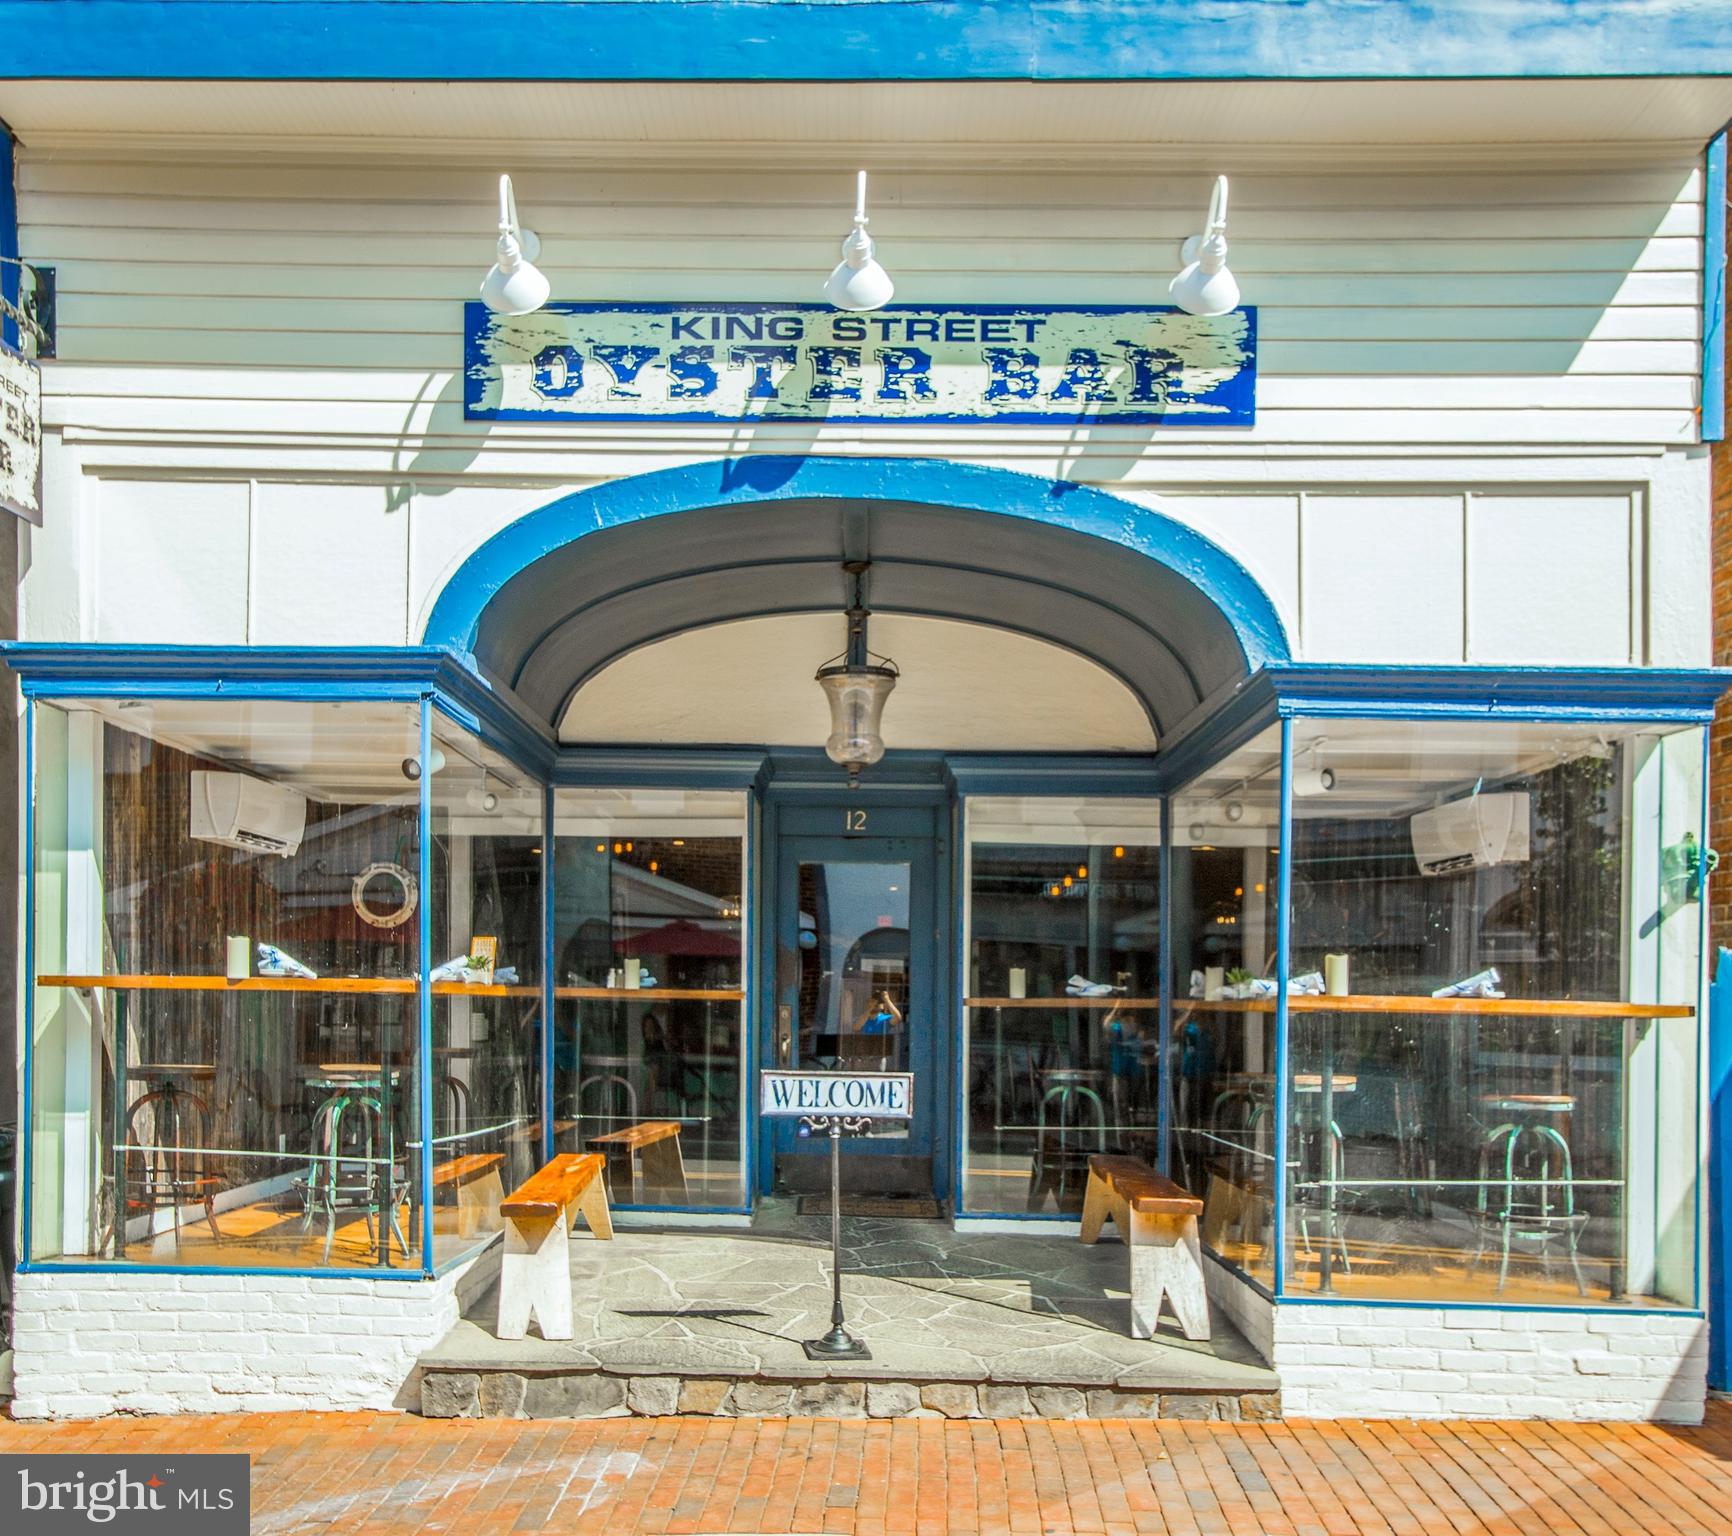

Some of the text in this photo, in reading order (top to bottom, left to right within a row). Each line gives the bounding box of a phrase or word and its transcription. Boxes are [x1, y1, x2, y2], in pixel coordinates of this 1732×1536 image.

[671, 316, 1047, 343] KING STREET
[529, 345, 1188, 405] OYSTER BAR
[846, 810, 867, 831] 12
[771, 1079, 904, 1109] WELCOME
